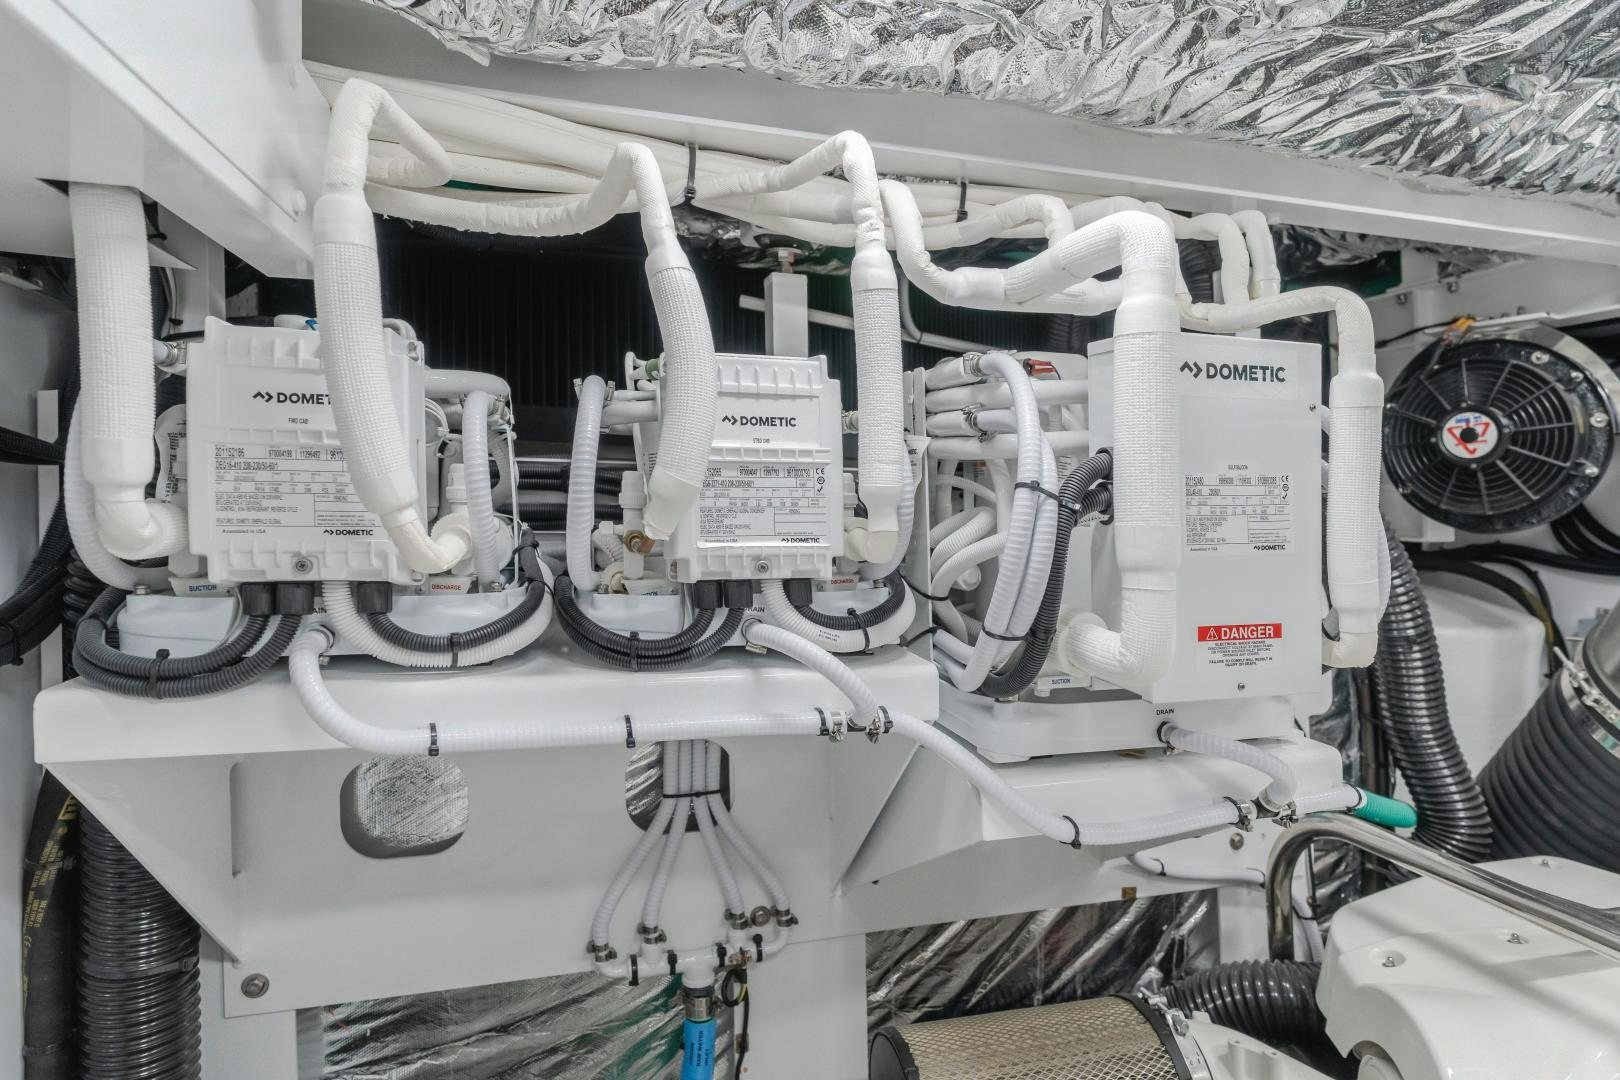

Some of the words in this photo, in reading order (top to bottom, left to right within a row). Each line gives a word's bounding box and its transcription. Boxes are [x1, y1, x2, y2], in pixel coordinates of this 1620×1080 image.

[1206, 362, 1286, 383] DOMETIC
[740, 416, 797, 427] DOMETIC
[188, 584, 218, 592] SUCTION
[1221, 626, 1274, 640] DANGER
[1156, 707, 1175, 716] DRAIN
